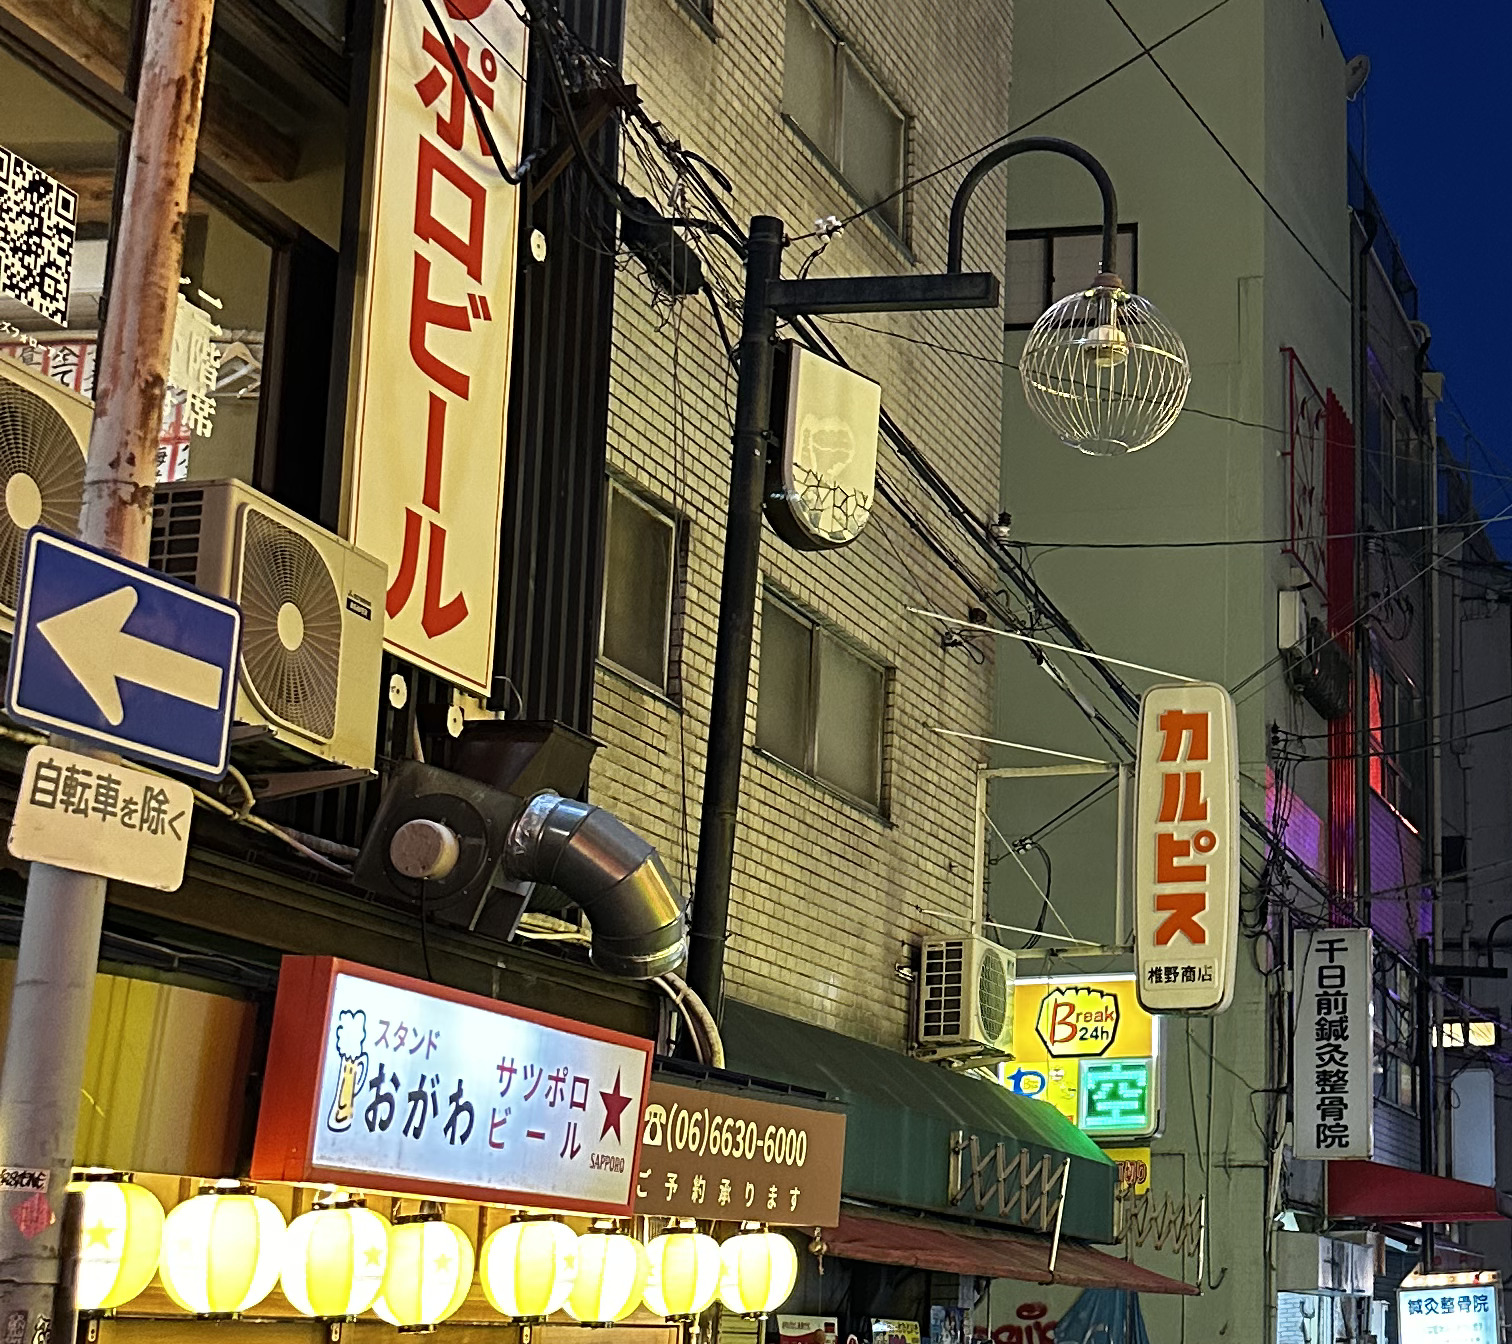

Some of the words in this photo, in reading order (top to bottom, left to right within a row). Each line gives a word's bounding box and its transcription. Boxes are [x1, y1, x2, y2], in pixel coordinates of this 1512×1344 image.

[30, 757, 186, 841] 自転車を除く
[1154, 709, 1218, 946] カルピス
[374, 1019, 441, 1060] スタンド
[1050, 998, 1115, 1046] Break
[1079, 1026, 1110, 1041] 24h
[1315, 937, 1350, 1149] 千日前鍼灸整骨院
[364, 1063, 476, 1146] おがわ
[488, 1106, 581, 1160] ビール
[667, 1108, 808, 1168] (06)6630-6000
[590, 1152, 626, 1174] SAPPORO
[636, 1168, 803, 1212] ご予約承ります
[1408, 1294, 1490, 1316] 鍼灸整骨院
